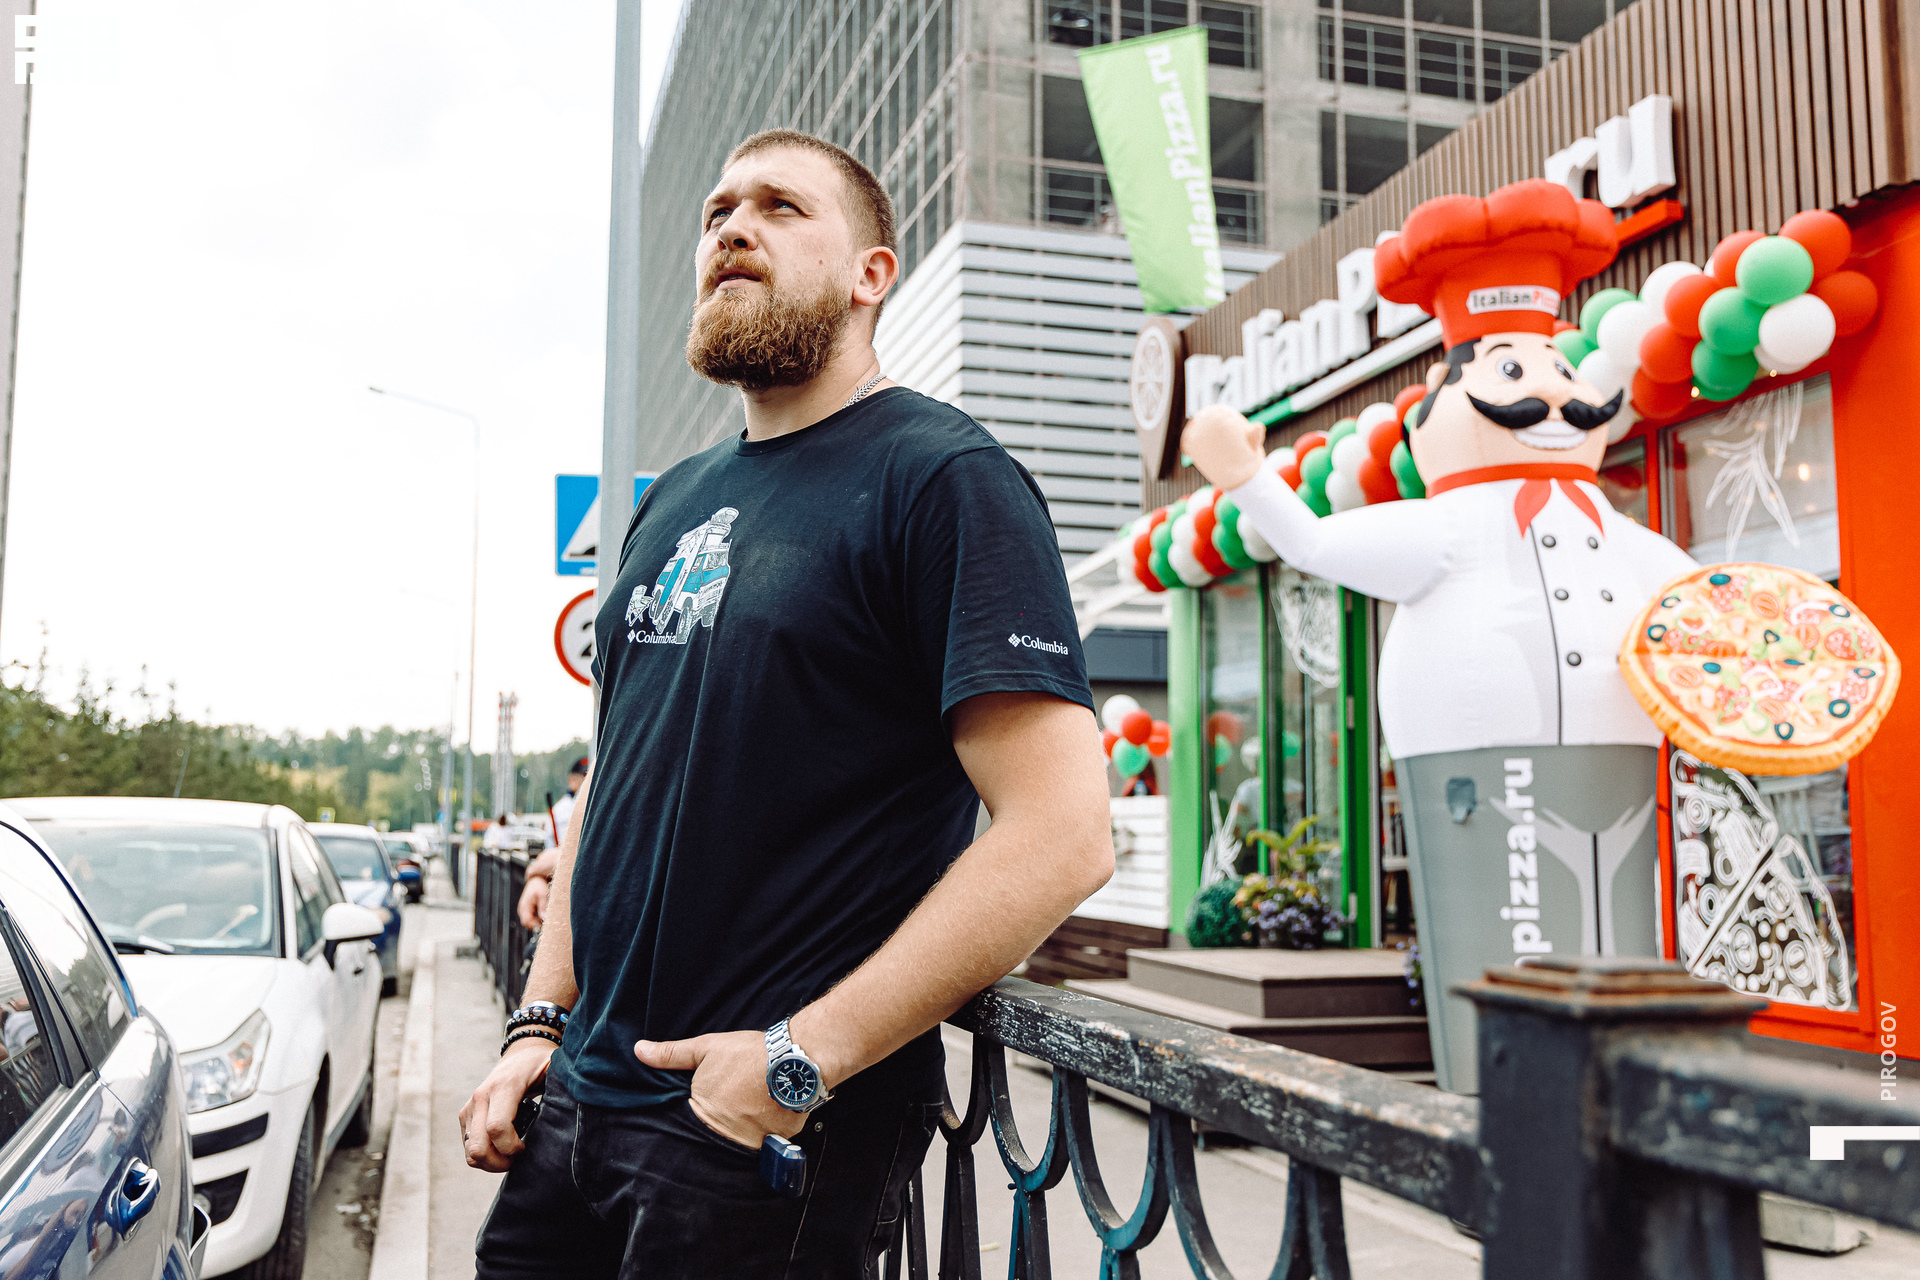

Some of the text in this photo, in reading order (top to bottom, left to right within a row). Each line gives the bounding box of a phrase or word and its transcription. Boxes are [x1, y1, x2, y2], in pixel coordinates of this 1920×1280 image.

[1473, 290, 1559, 310] ItalianPi
[635, 630, 678, 645] Columbia
[1021, 635, 1069, 656] Columbia
[1500, 758, 1553, 968] pizza.ru
